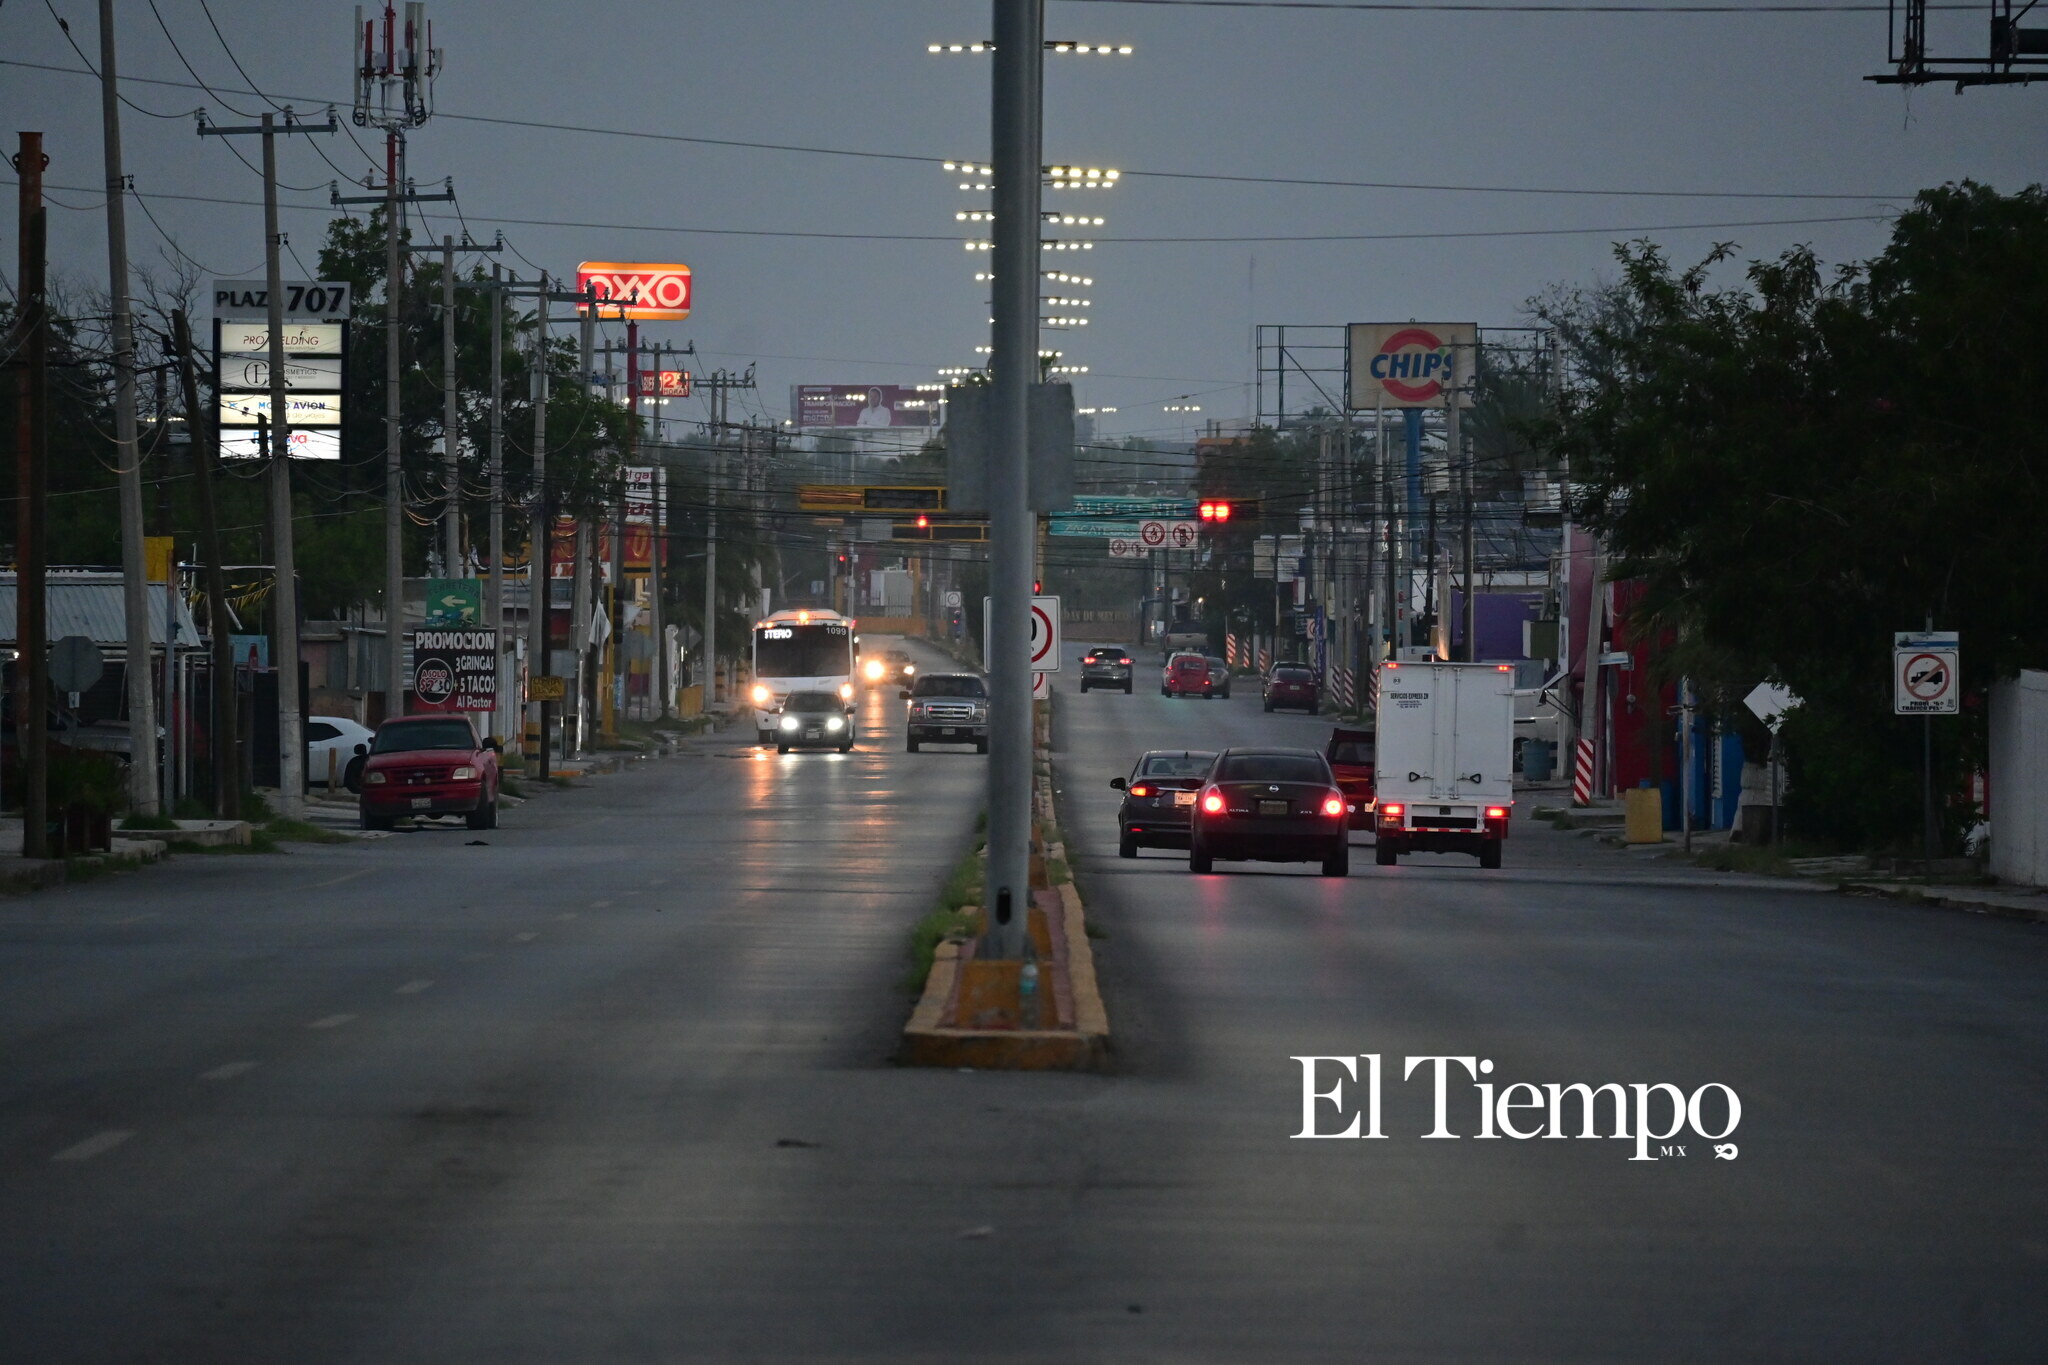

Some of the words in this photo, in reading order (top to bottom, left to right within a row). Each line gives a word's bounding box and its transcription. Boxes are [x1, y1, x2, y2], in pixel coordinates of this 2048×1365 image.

[216, 290, 282, 308] PLAZ
[286, 286, 345, 313] 707
[584, 275, 687, 307] OXXO
[826, 627, 847, 636] 1099
[415, 632, 496, 650] PROMOCION
[460, 677, 465, 692] 5
[467, 675, 496, 693] TACOS
[456, 696, 466, 708] Al
[467, 696, 492, 708] Pastor
